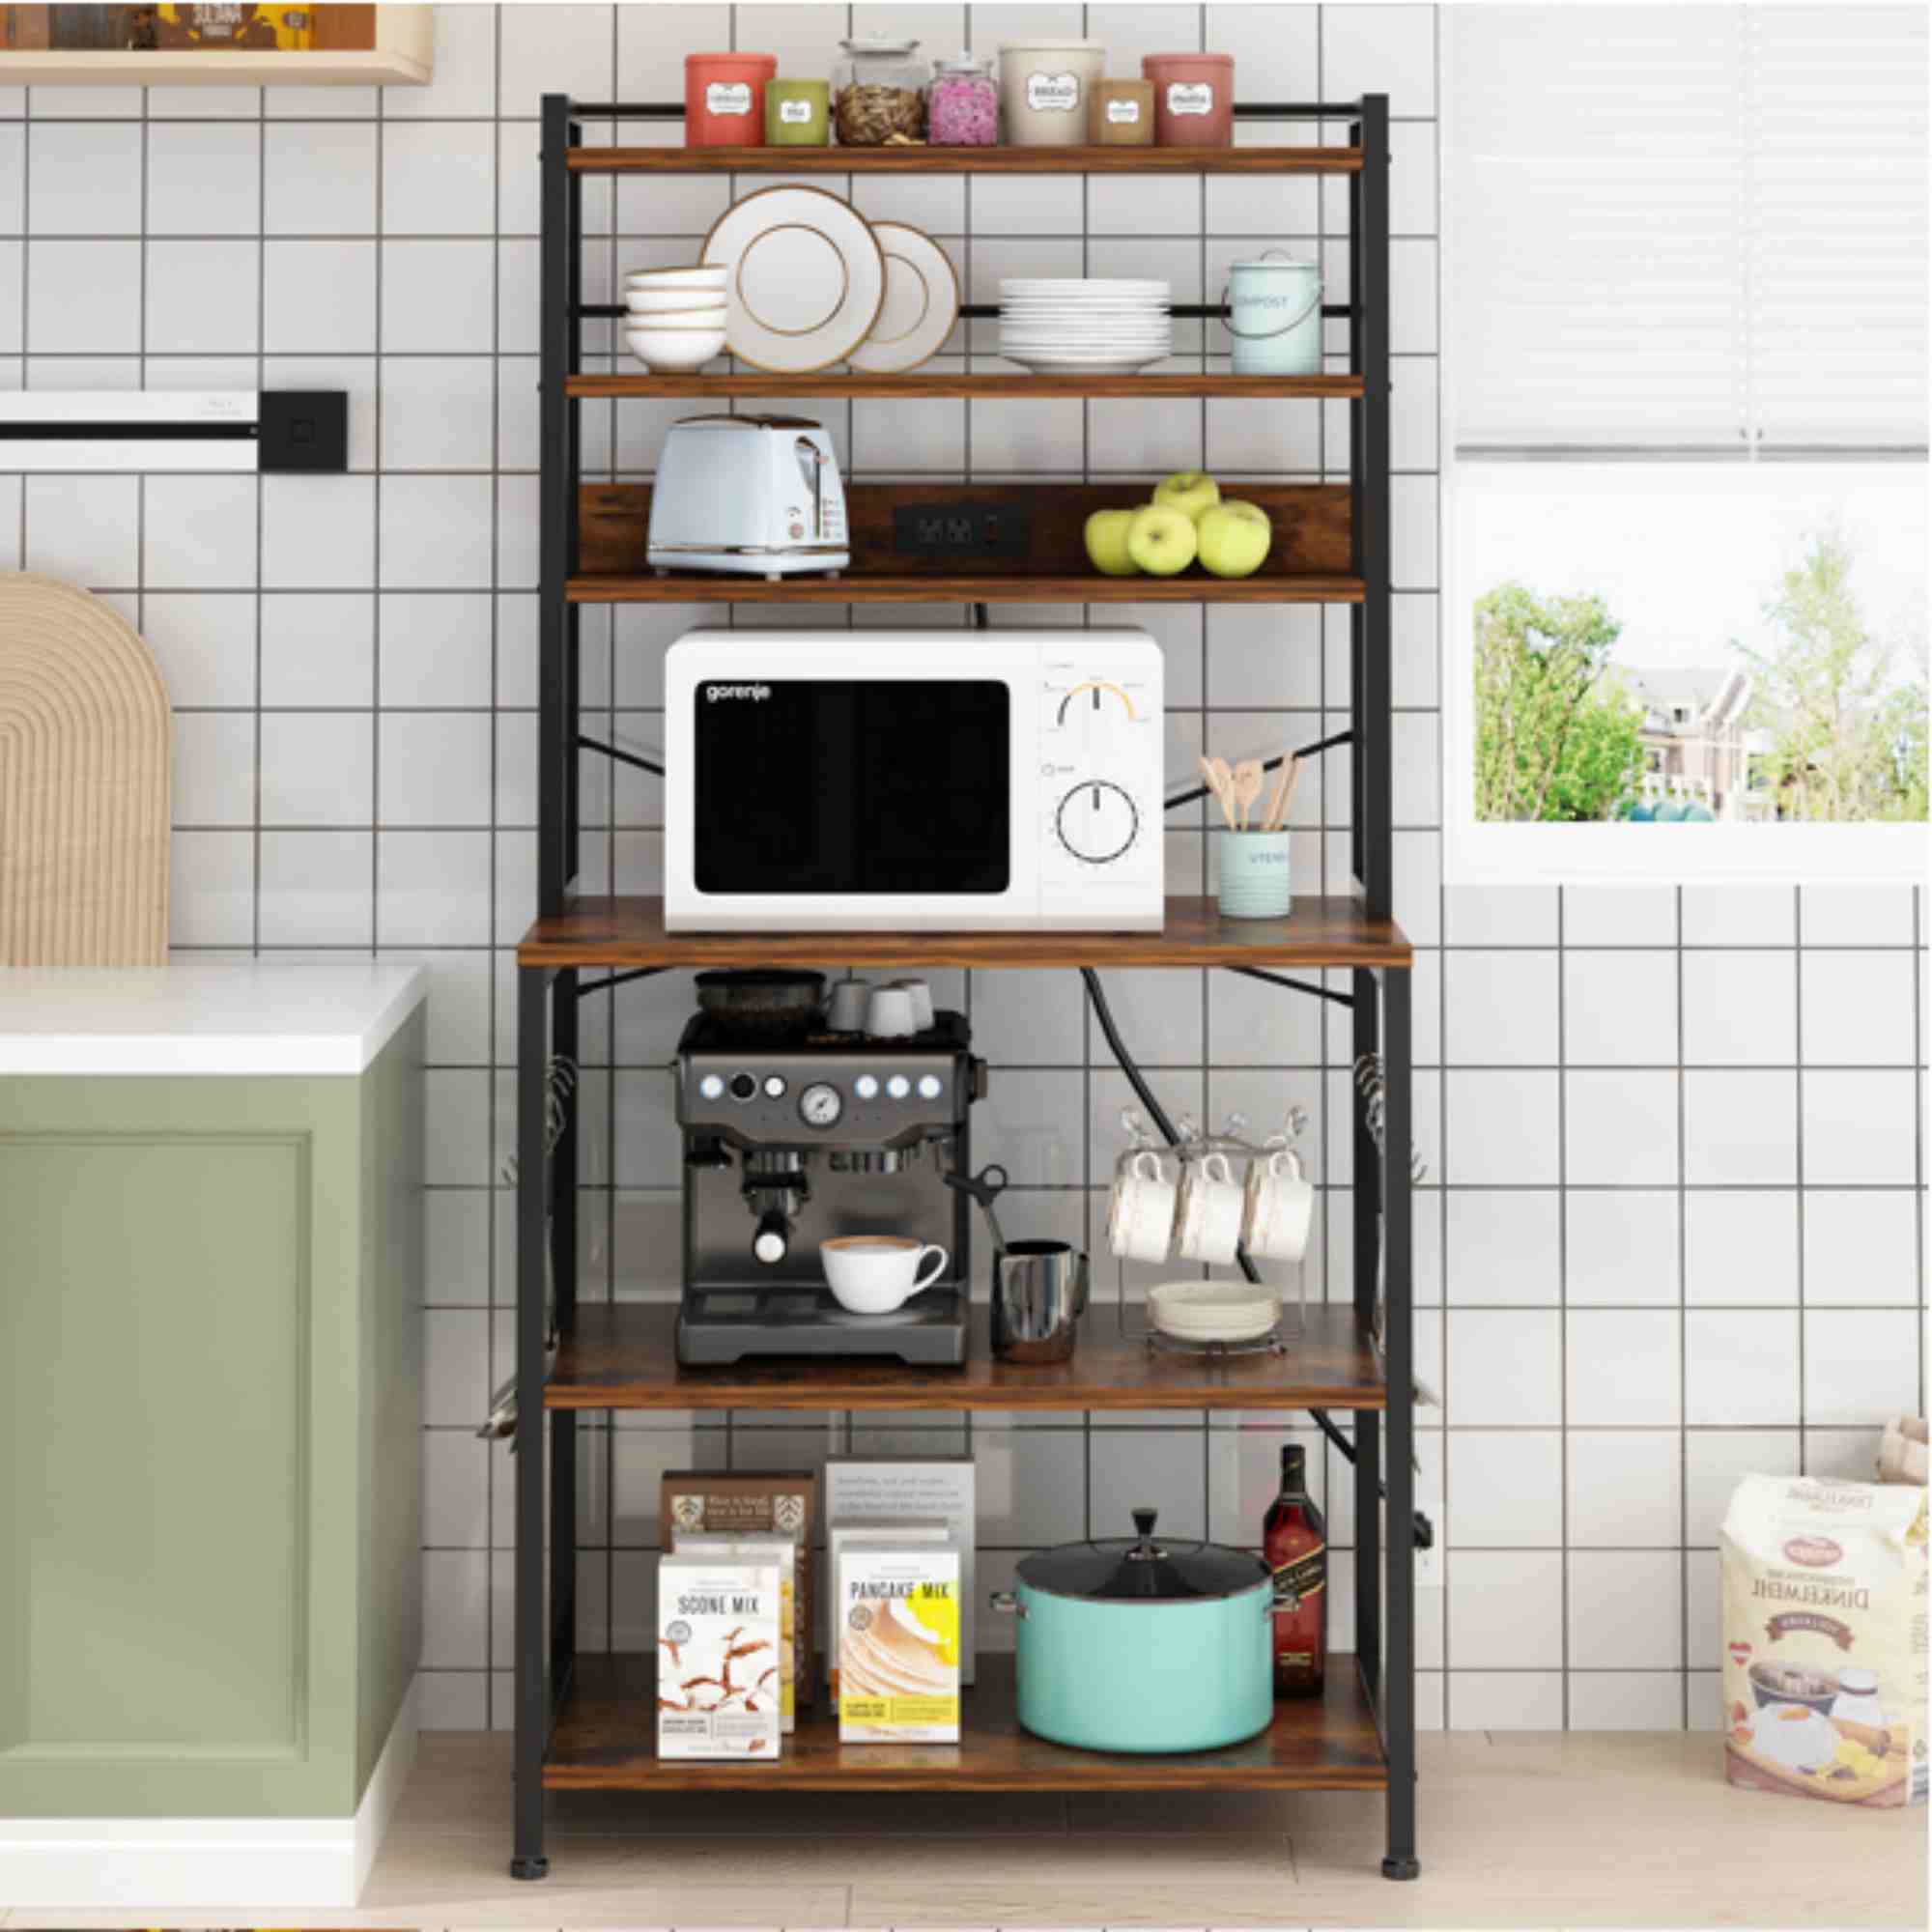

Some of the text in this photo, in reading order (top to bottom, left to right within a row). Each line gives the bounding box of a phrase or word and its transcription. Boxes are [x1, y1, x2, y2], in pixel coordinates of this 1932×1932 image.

[706, 681, 771, 703] gorenje
[850, 1580, 949, 1599] PANCAKE MIX
[677, 1595, 759, 1615] SCONE MIX
